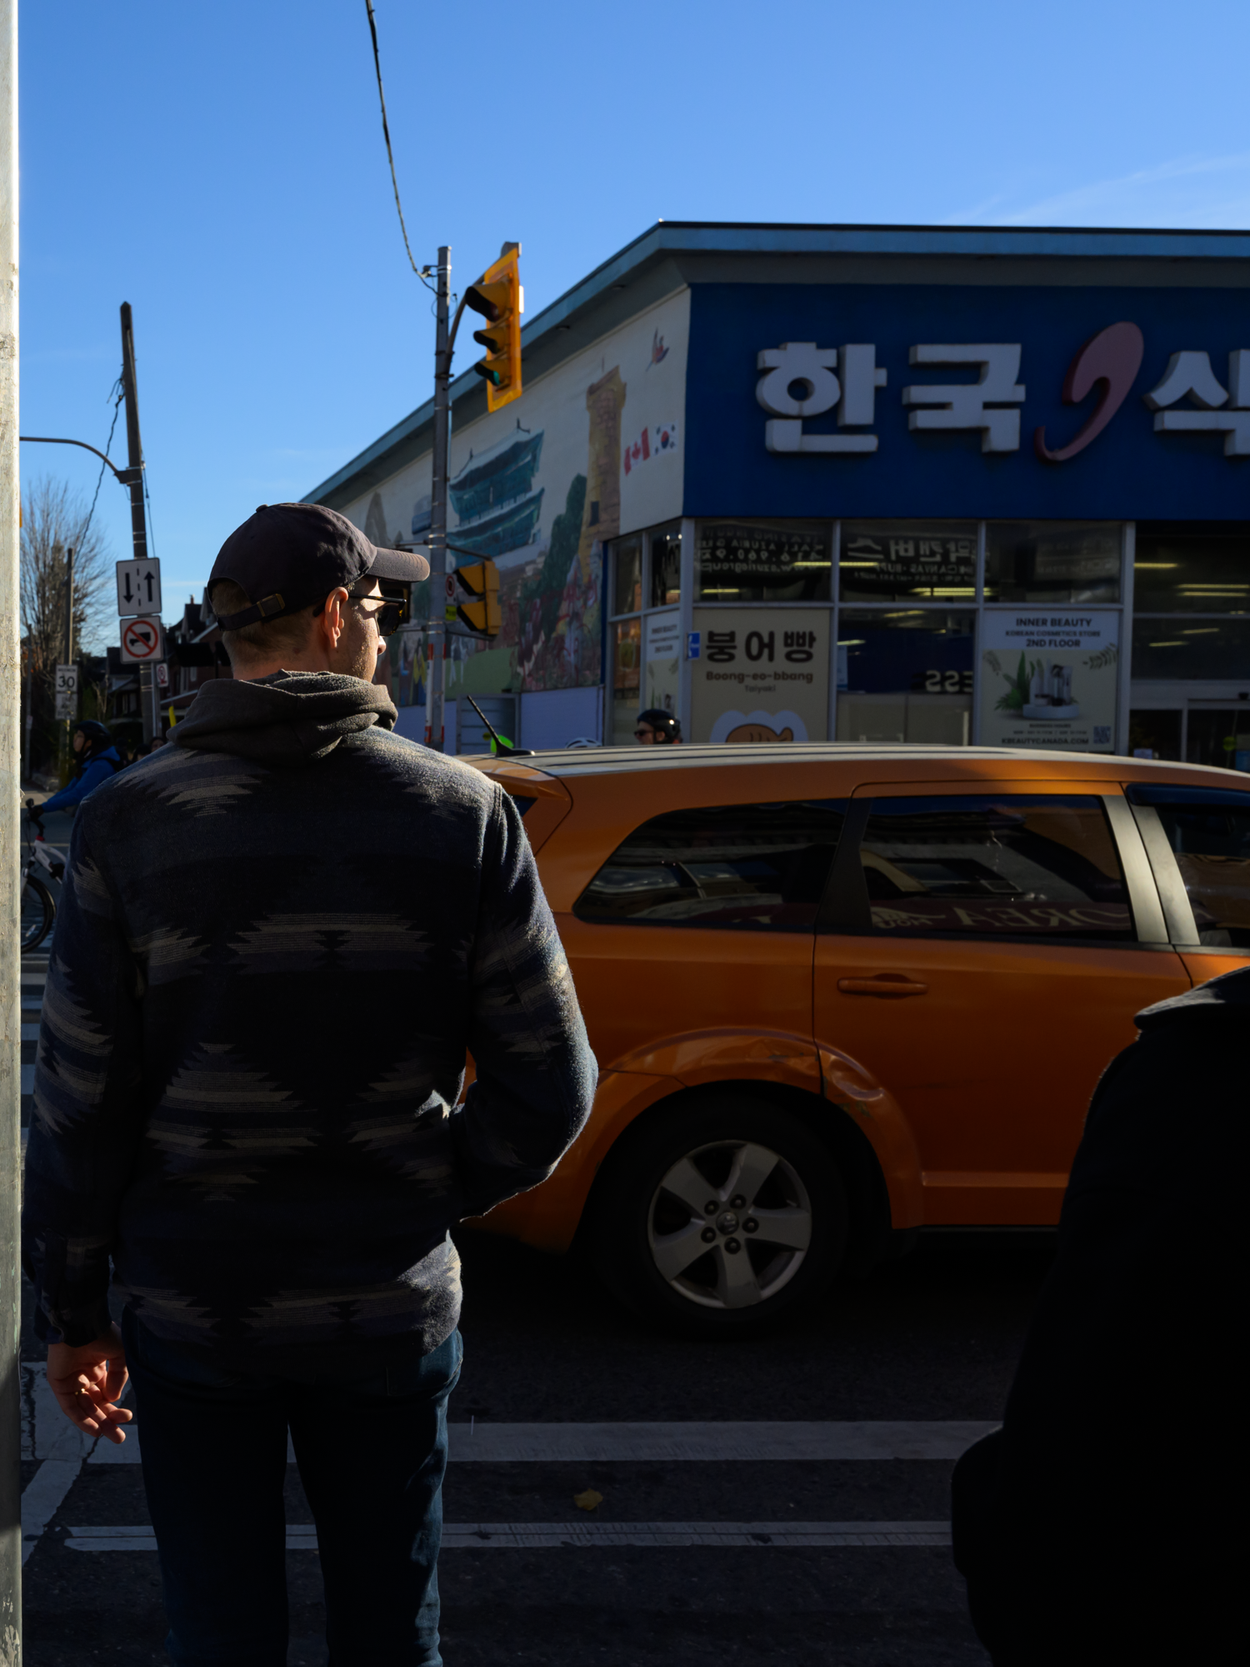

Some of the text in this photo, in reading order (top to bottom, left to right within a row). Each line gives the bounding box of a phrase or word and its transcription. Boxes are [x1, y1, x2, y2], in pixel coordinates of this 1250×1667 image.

[756, 341, 1026, 453] 한국
[1016, 618, 1092, 627] INNER BEAUTY
[706, 631, 816, 662] 붕어빵
[1026, 639, 1081, 647] 2ND FLOOR
[58, 675, 75, 688] 30
[706, 671, 813, 684] Boong-eo-bbang
[744, 684, 776, 694] Taiyaki
